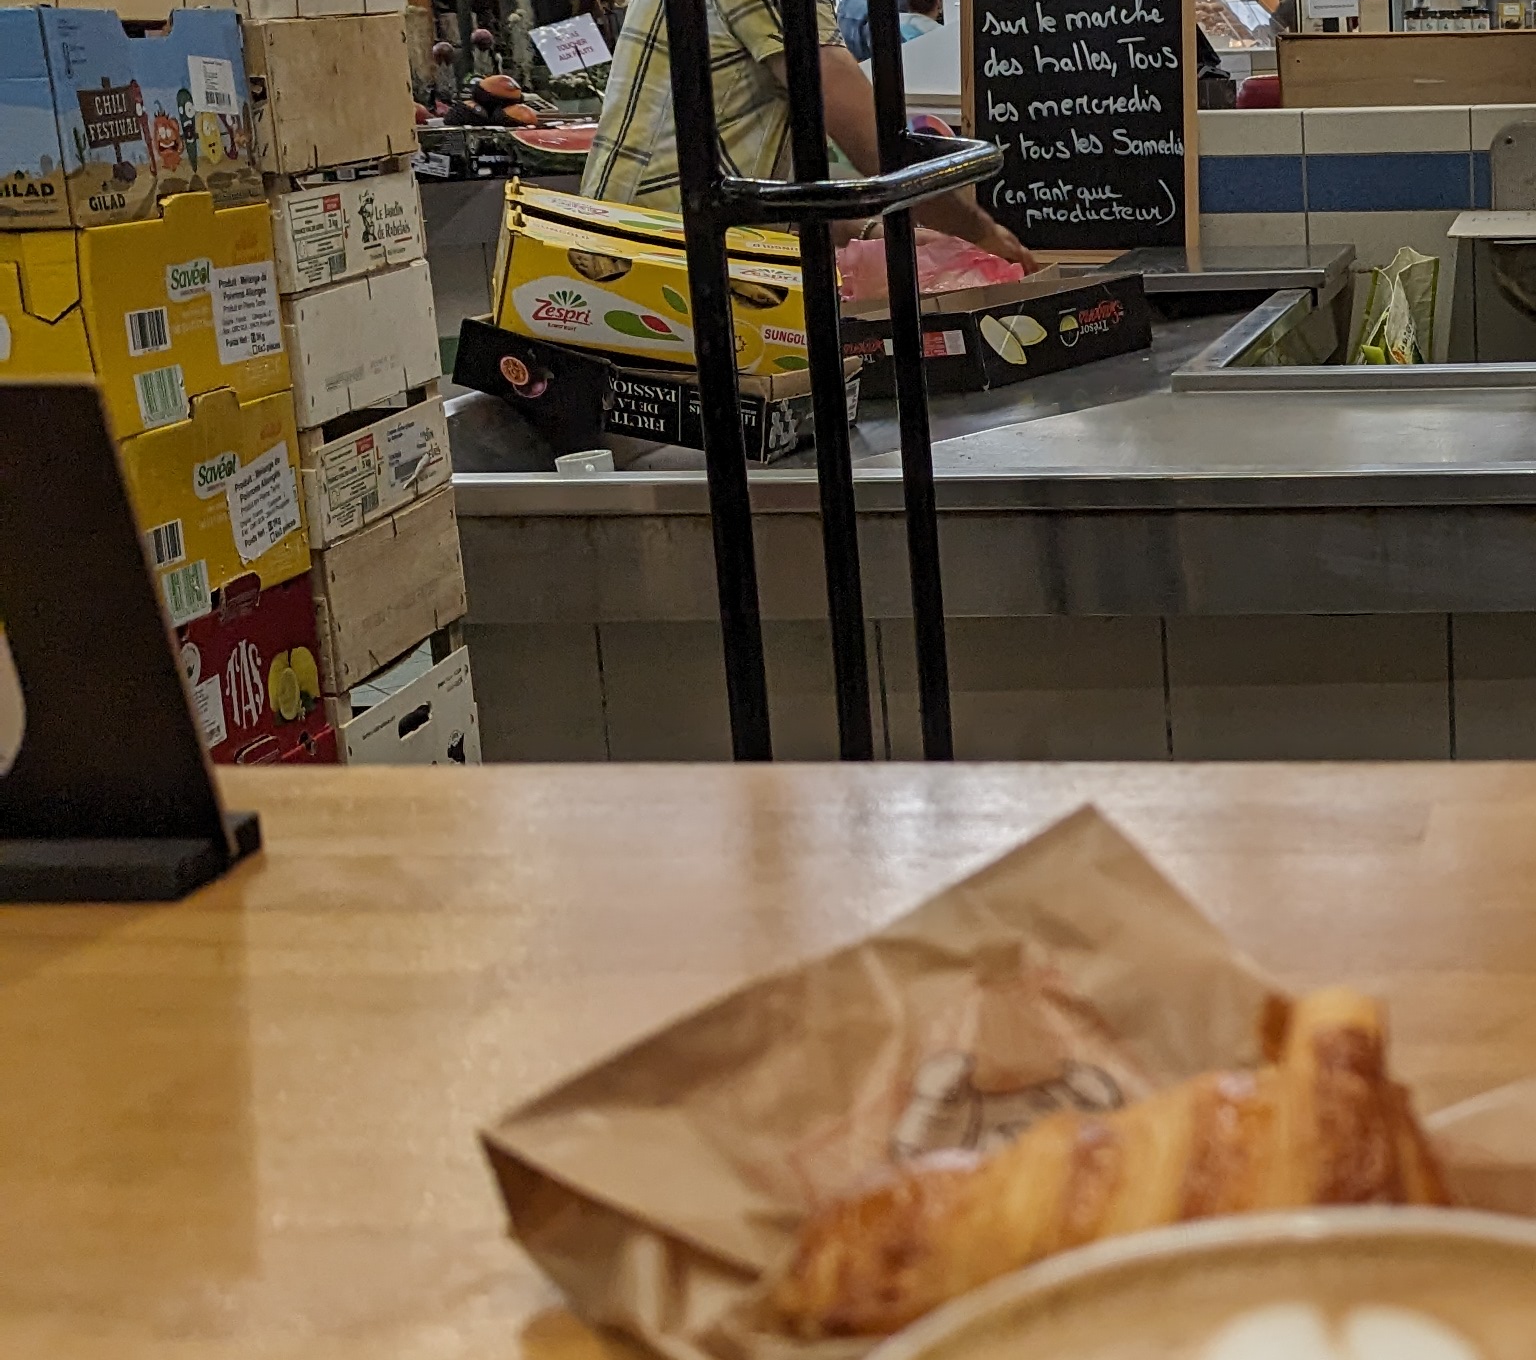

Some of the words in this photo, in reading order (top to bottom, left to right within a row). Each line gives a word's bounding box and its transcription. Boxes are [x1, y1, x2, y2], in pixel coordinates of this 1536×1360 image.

[982, 11, 1029, 36] sur
[1036, 1, 1057, 34] le
[984, 46, 1024, 78] des
[94, 93, 127, 117] CHILI
[988, 89, 1019, 123] les
[1028, 84, 1163, 121] mercredis
[88, 118, 140, 142] FESTIVAL
[1019, 132, 1071, 160] tous
[1070, 128, 1105, 156] les
[0, 183, 55, 197] ILAD
[89, 193, 127, 212] GILAD
[1076, 185, 1123, 211] que
[171, 261, 212, 291] Savéol
[531, 297, 592, 326] Zespri
[764, 328, 807, 346] SUNGOL
[197, 453, 236, 487] Savéol
